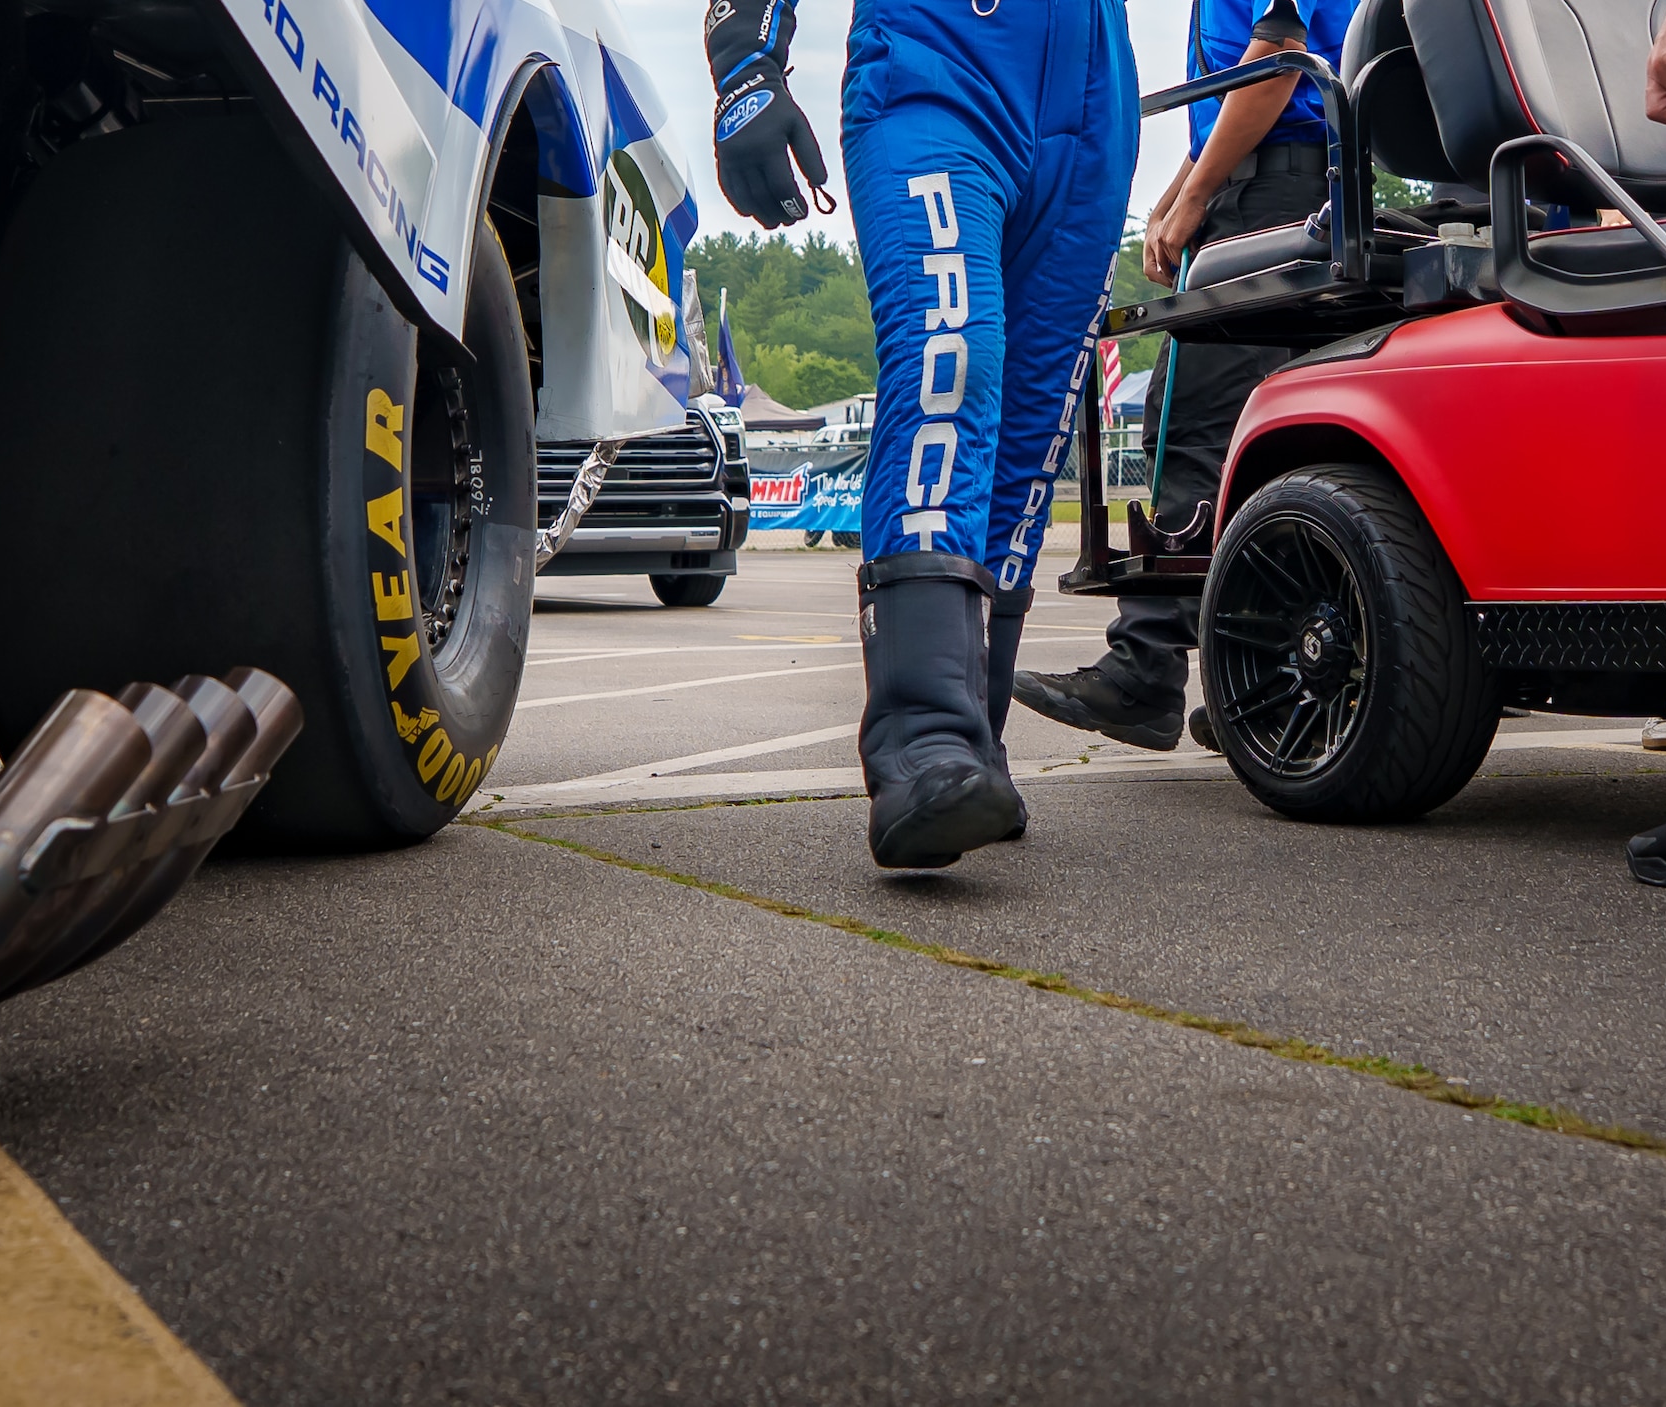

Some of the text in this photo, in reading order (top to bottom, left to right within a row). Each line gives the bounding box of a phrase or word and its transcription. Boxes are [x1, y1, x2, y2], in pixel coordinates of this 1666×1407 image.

[723, 96, 760, 133] Ford
[312, 58, 449, 295] RACING
[750, 474, 803, 502] MMIT
[811, 473, 833, 494] The
[366, 387, 422, 692] YEAR
[998, 479, 1048, 592] ORD
